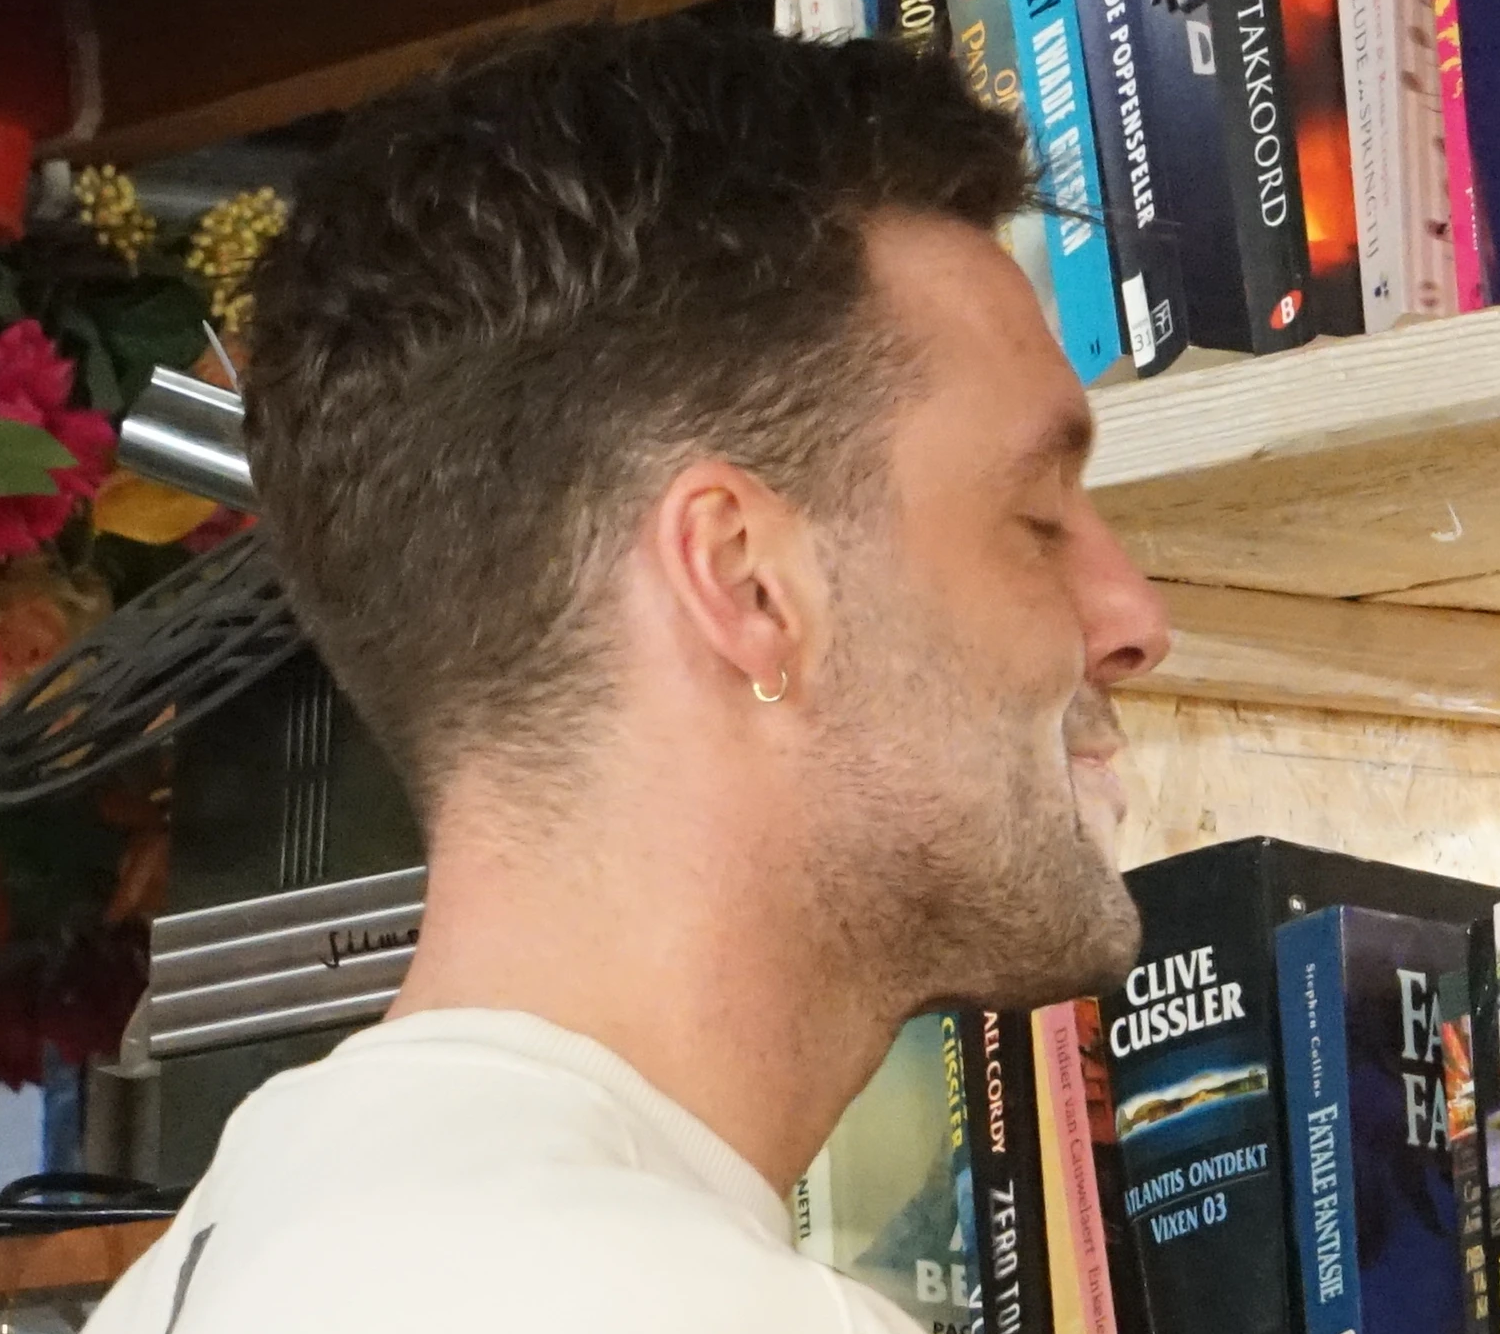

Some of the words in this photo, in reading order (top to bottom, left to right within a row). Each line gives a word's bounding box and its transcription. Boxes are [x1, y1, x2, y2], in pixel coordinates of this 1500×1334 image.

[1110, 23, 1154, 229] POPPENSPELER
[1126, 947, 1218, 1007] CLIVE
[1054, 1027, 1071, 1087] Didier
[1110, 982, 1245, 1058] CUSSLER
[986, 1062, 1005, 1155] CORDY
[1064, 1089, 1077, 1131] van
[1308, 1103, 1338, 1195] FATALE
[1070, 1138, 1096, 1257] Cauwelaert
[1151, 1201, 1198, 1245] VIXEN
[1204, 1193, 1226, 1229] 03
[1311, 1197, 1344, 1302] FANTASIE
